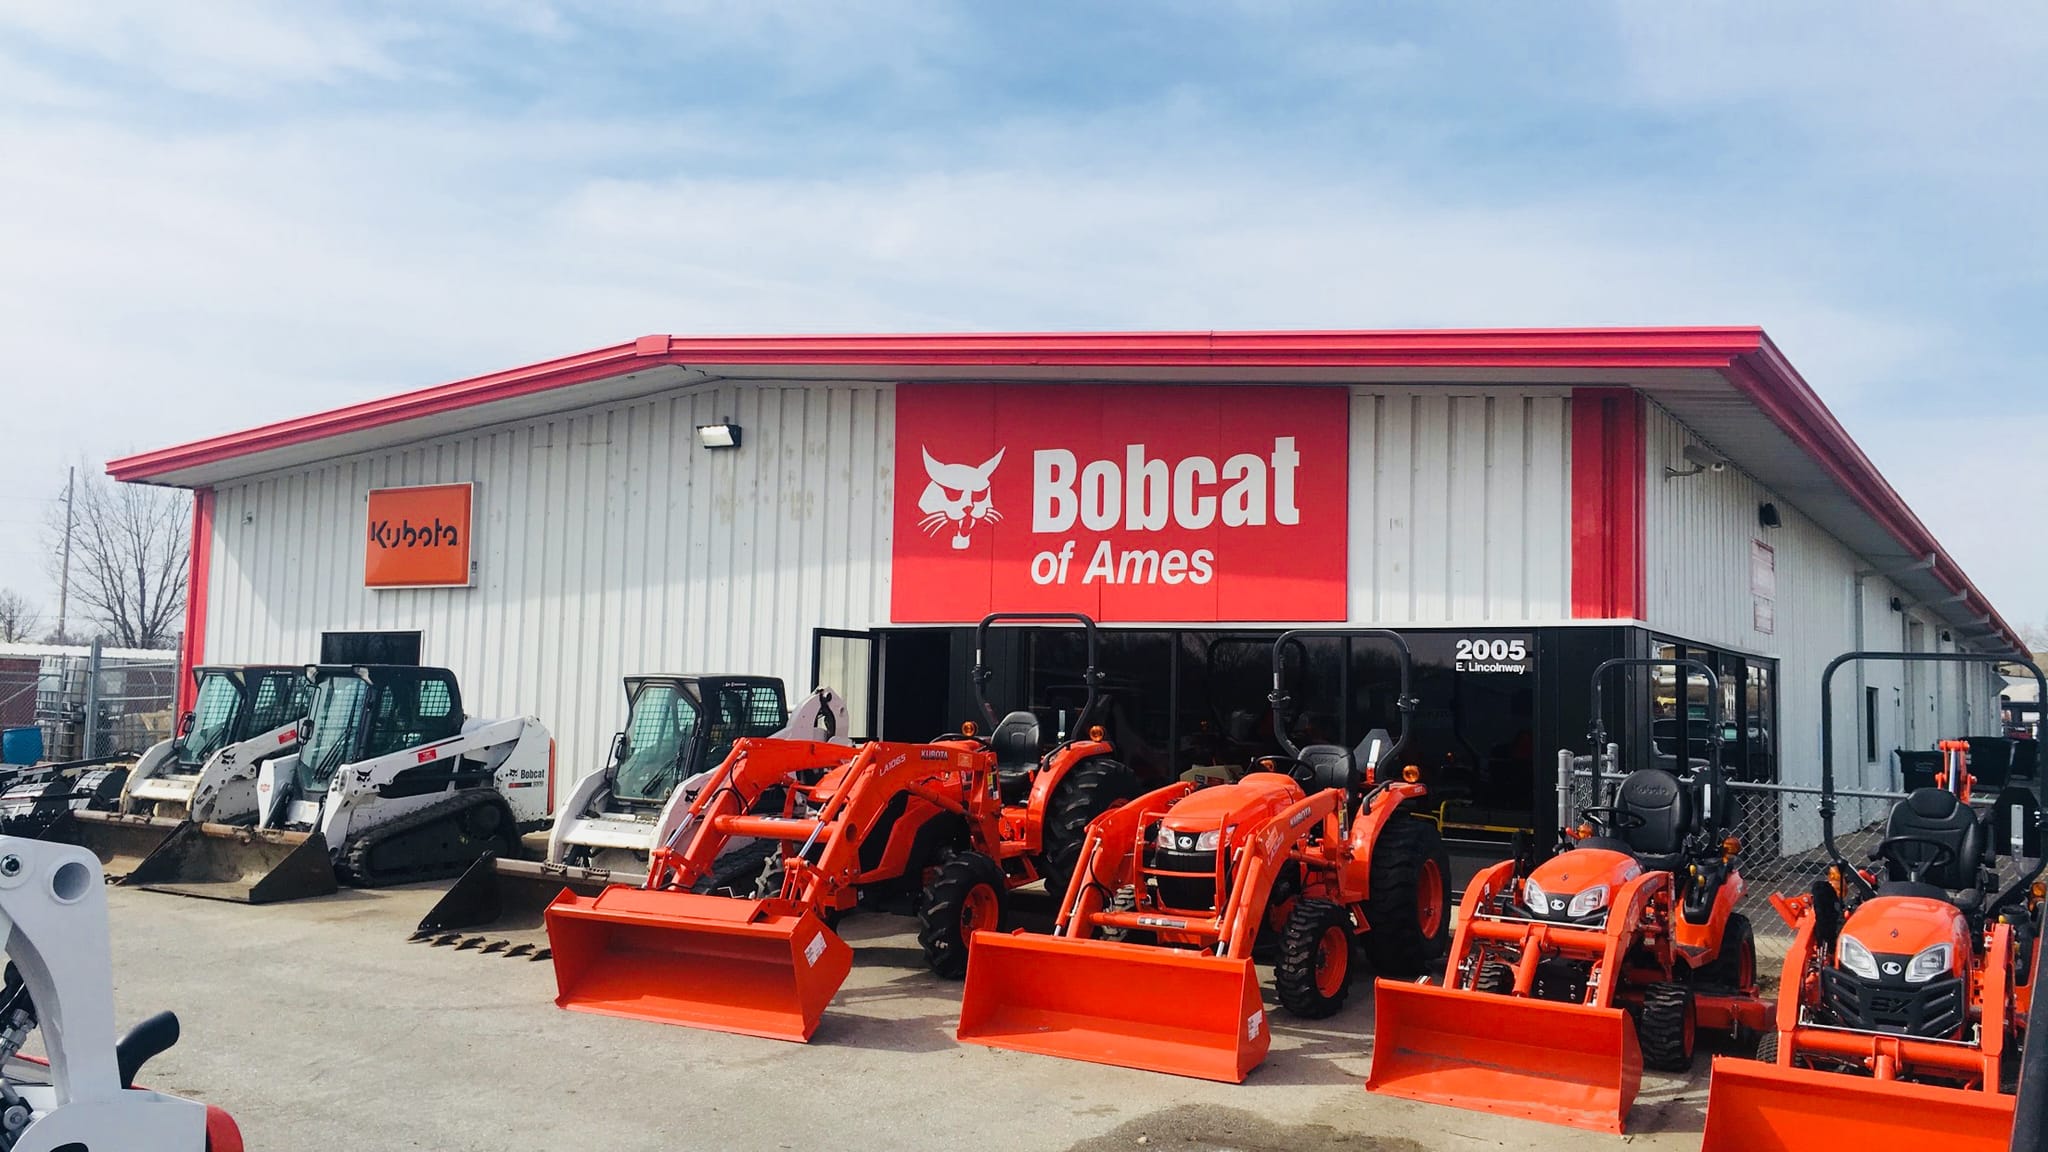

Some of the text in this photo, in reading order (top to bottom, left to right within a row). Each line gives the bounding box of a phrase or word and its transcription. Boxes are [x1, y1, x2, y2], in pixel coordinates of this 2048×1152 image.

[1032, 436, 1300, 533] Bobcat
[370, 517, 458, 549] Kubota
[1030, 540, 1215, 585] of Ames
[1455, 639, 1527, 661] 2005
[1455, 662, 1526, 675] E. Lincolnway
[921, 749, 949, 761] KUBOTA
[520, 768, 545, 780] Bobcat
